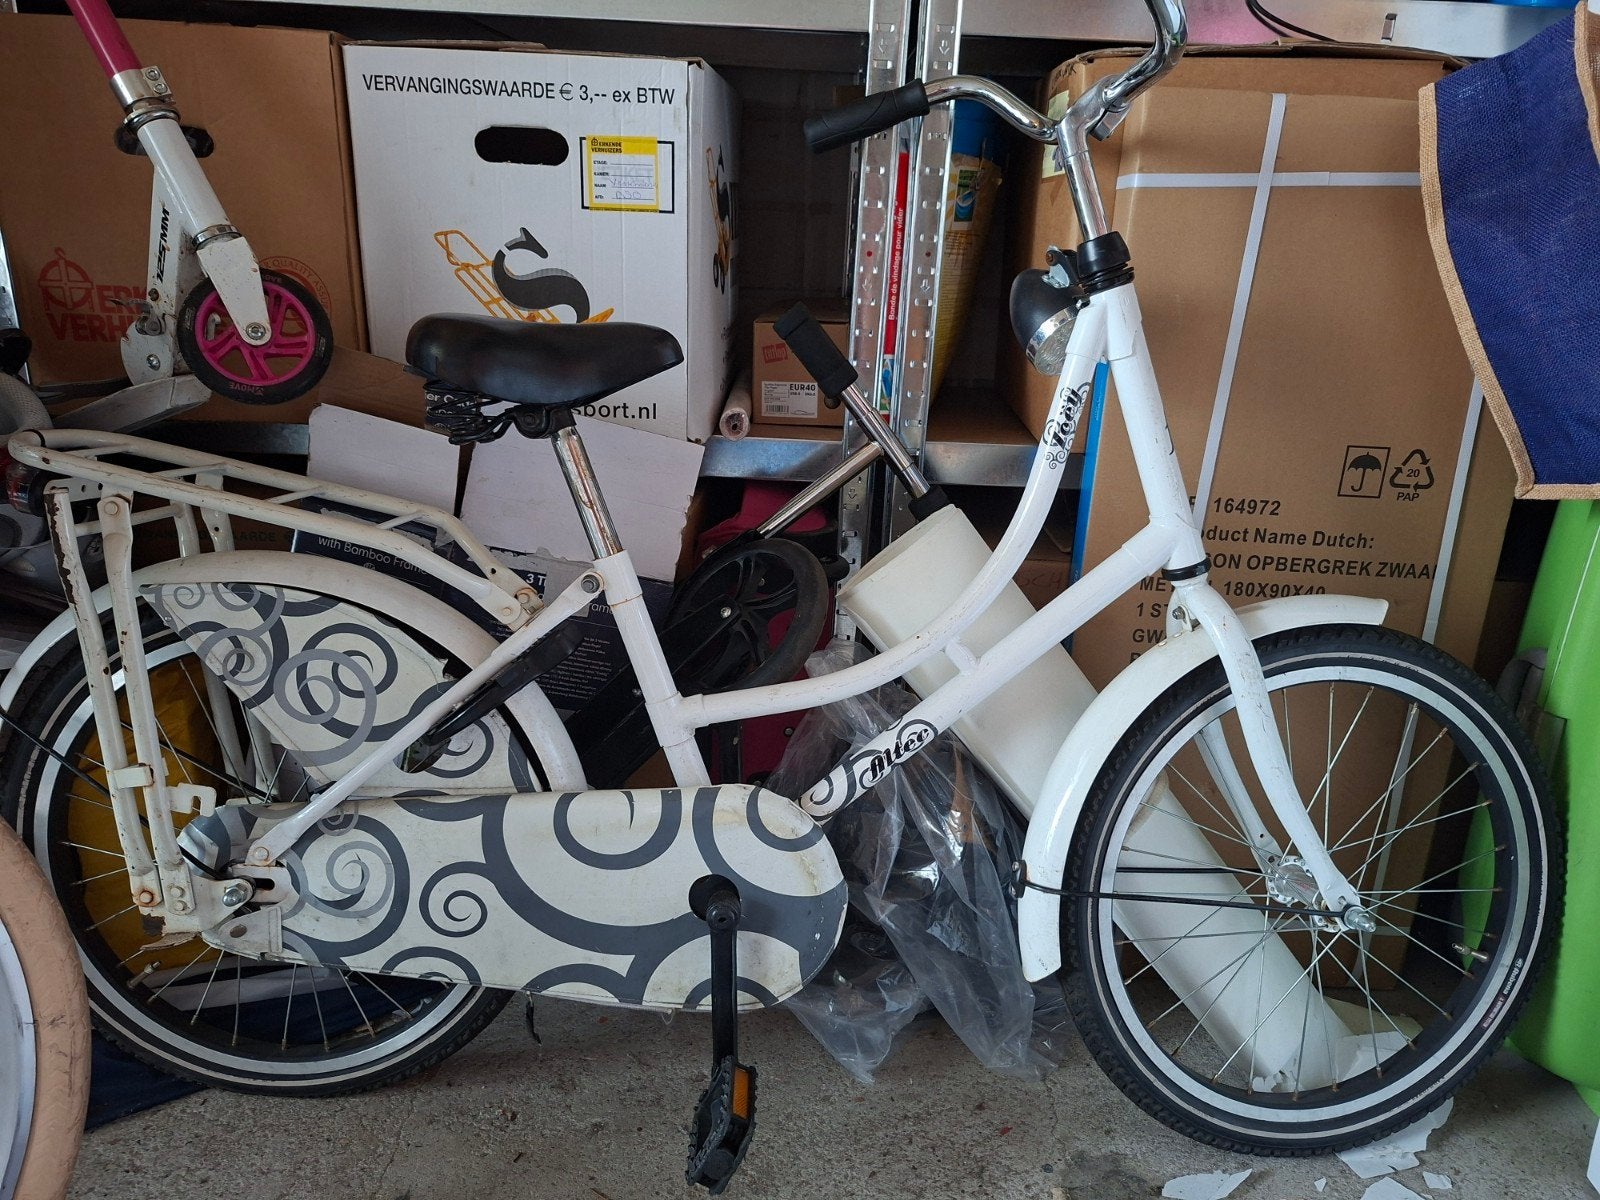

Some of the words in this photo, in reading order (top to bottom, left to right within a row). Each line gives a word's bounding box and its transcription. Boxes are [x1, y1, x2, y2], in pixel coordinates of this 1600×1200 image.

[362, 73, 555, 99] VERVANGINGSWAARDE
[559, 82, 574, 101] €
[612, 89, 631, 103] ex
[637, 87, 675, 105] BTW
[789, 383, 816, 391] EUR40
[1407, 468, 1420, 478] 20
[1396, 492, 1420, 501] PAP
[1213, 497, 1281, 516] 164972
[1200, 525, 1249, 543] duct
[1253, 527, 1307, 546] Name
[1312, 530, 1374, 549] Dutch:
[318, 536, 341, 550] with
[343, 541, 391, 564] Bamboo
[1246, 554, 1373, 577] OPBERGREK
[525, 573, 535, 584] 3
[1137, 602, 1144, 617] 1
[868, 728, 930, 783] Altec
